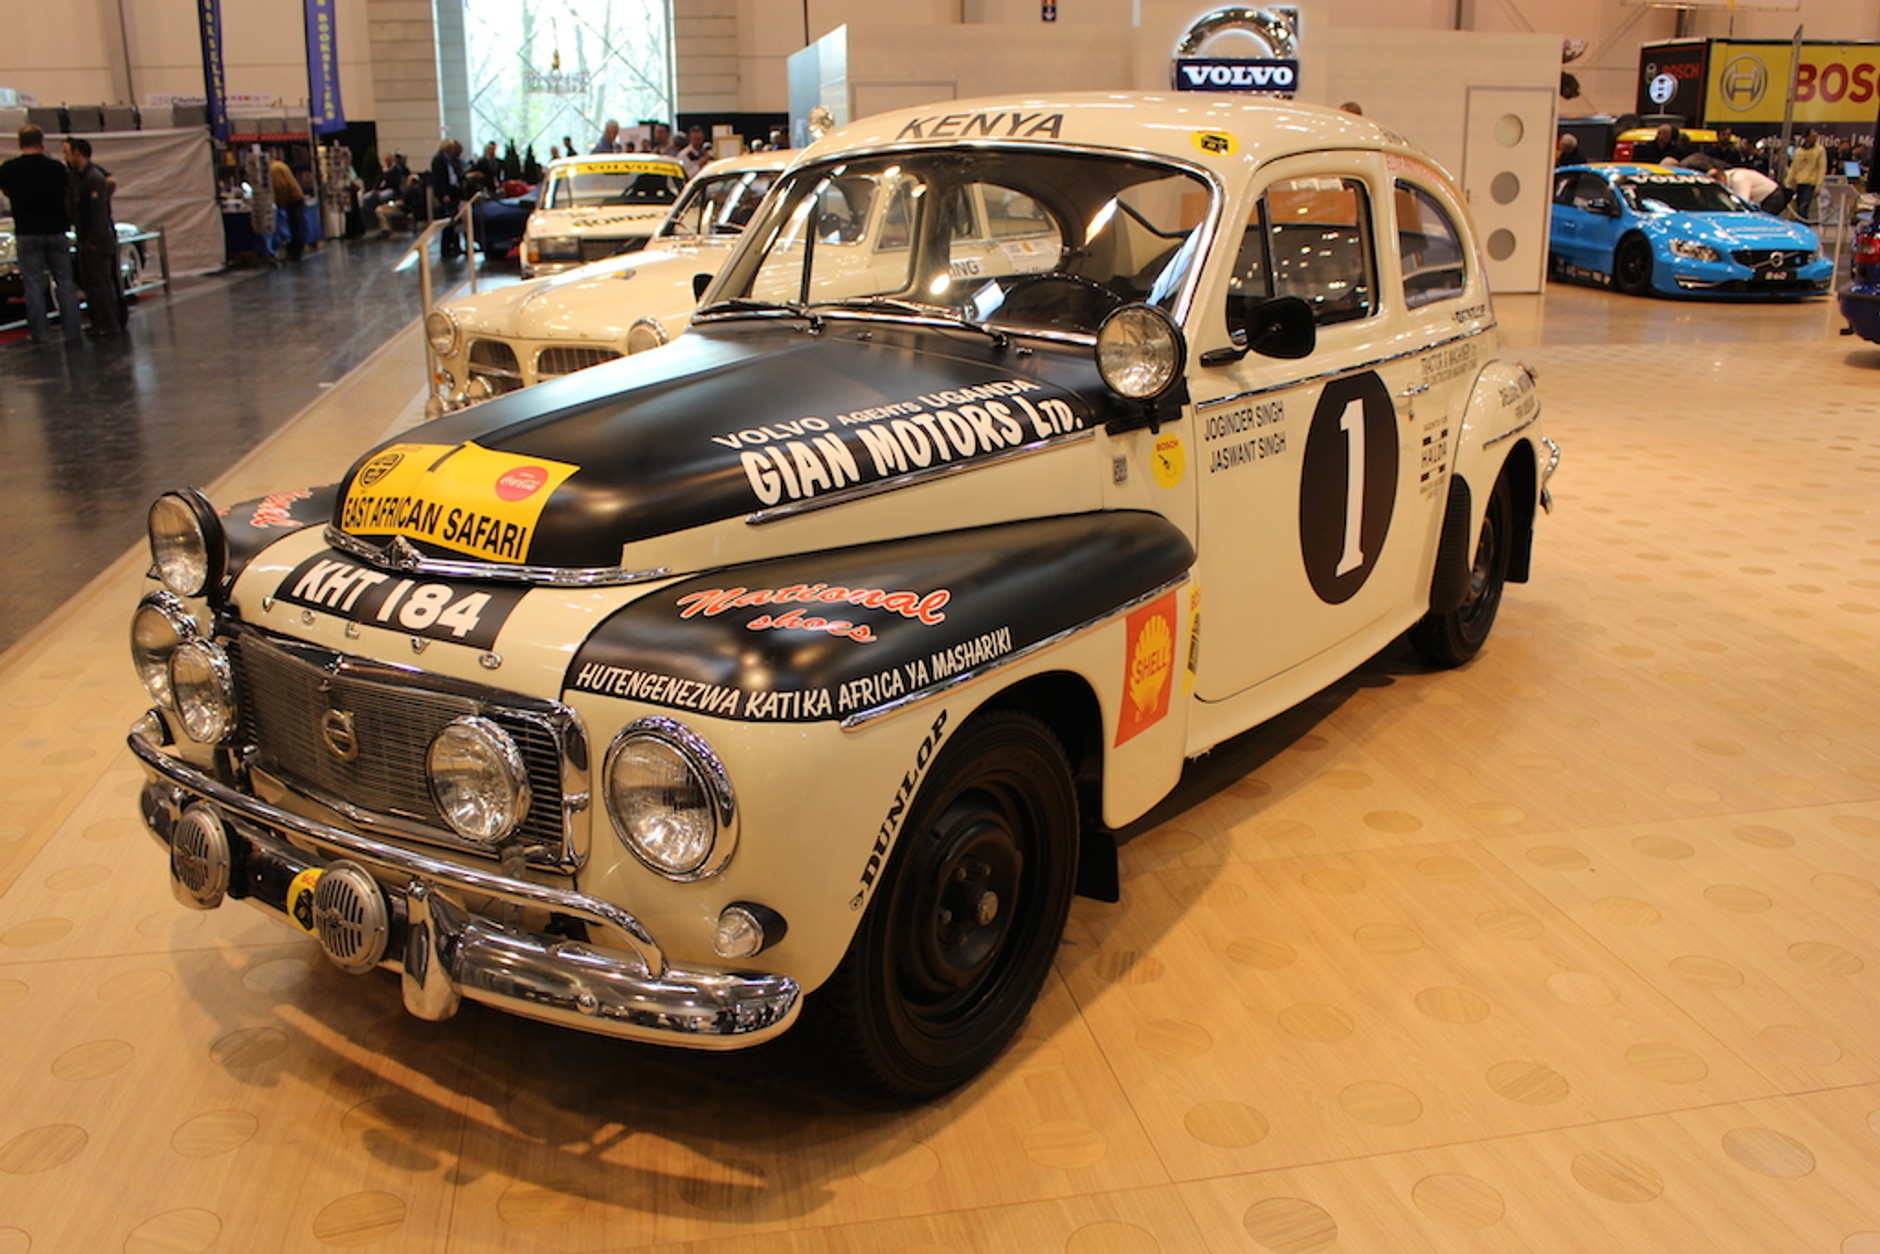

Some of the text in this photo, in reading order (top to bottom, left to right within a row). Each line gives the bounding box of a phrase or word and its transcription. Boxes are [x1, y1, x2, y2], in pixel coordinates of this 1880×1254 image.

[1182, 66, 1293, 85] VOLVO
[1793, 62, 1880, 103] BOS
[896, 112, 1064, 141] KENYA
[711, 379, 1041, 449] VOLVO AGENTS UGANDA
[1204, 401, 1285, 441] JOGINDER SINGH
[740, 433, 860, 506] GIAN
[854, 401, 1024, 477] MOTORS
[1210, 431, 1287, 473] JASWANT SINGH
[1334, 397, 1364, 578] 1
[344, 497, 372, 528] EAST
[369, 496, 444, 536] AFRICAN
[442, 508, 528, 560] SAFARI
[291, 558, 493, 638] KHT 184
[676, 583, 951, 626] National
[746, 608, 877, 642] shoes
[577, 662, 741, 716] HUTENGENEZWA
[838, 668, 906, 713] AFRICA
[905, 658, 930, 693] YA
[931, 626, 1013, 681] MASHARIKI
[1133, 648, 1168, 685] SHELL
[860, 708, 948, 890] DUNLOP
